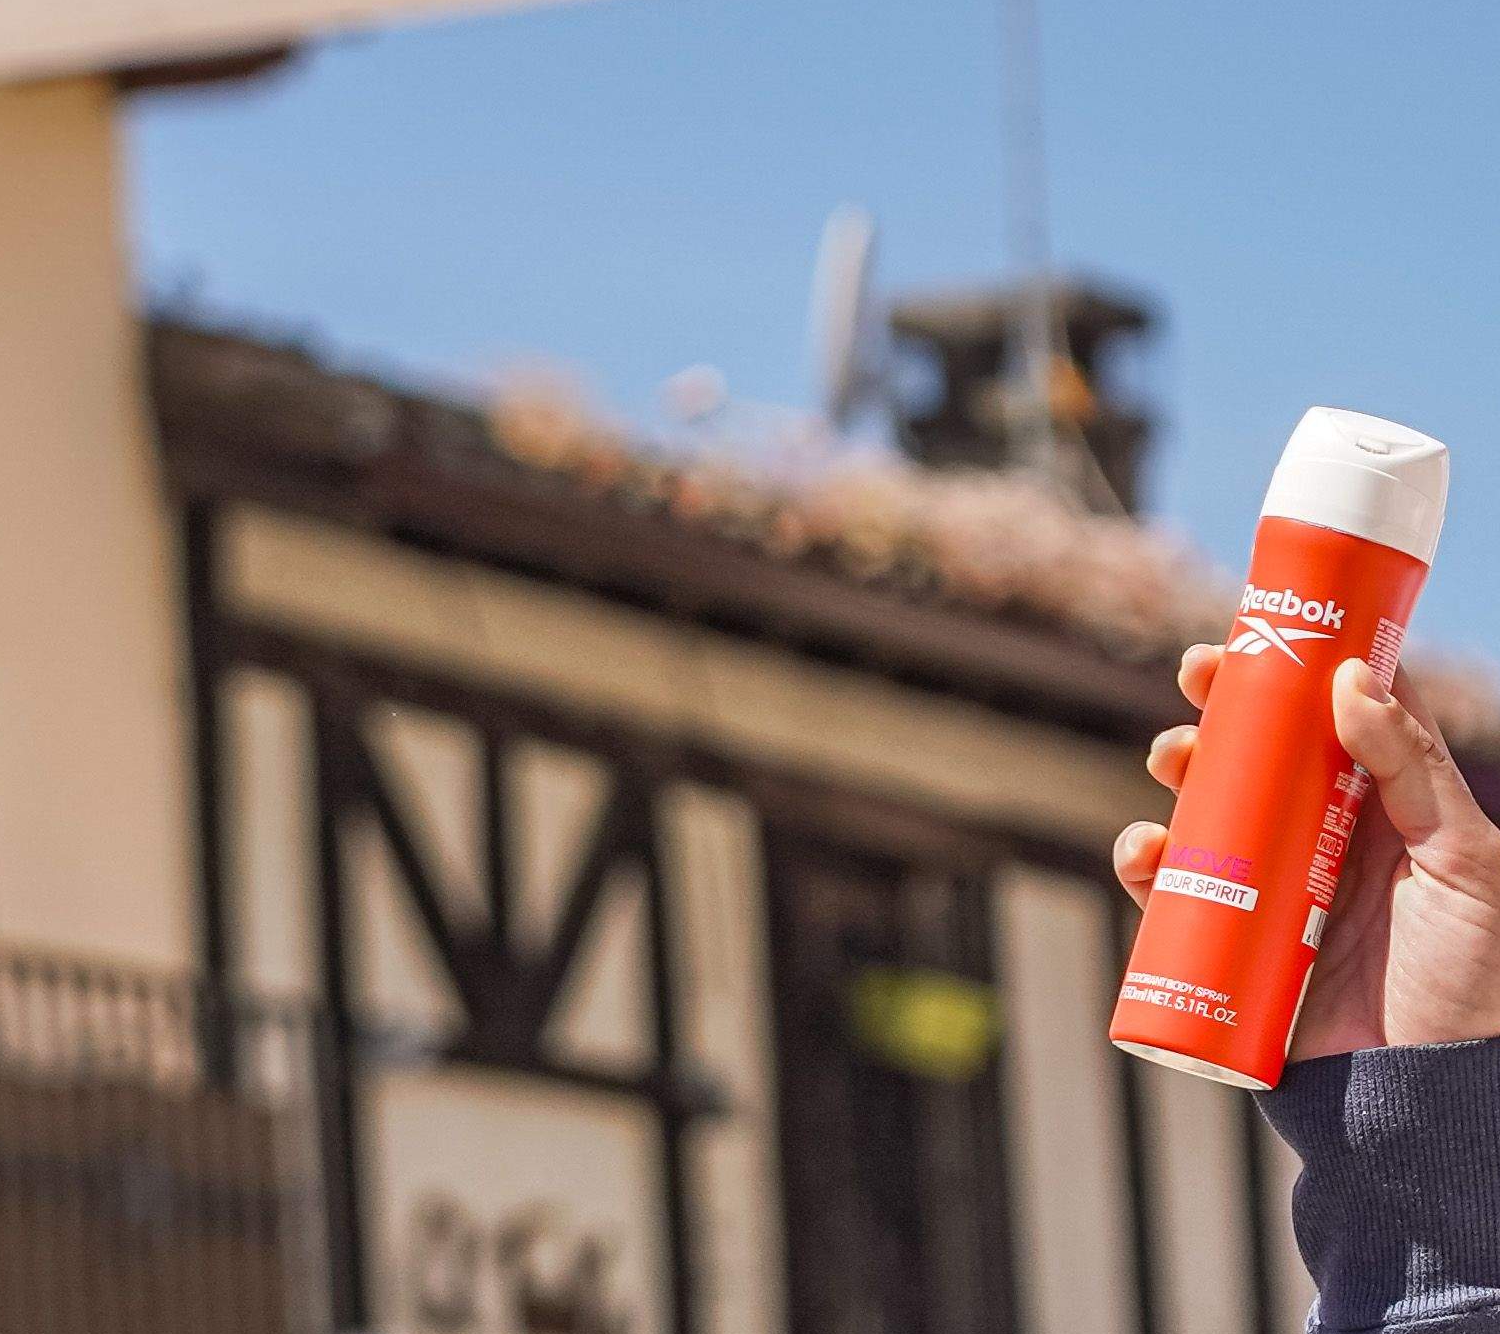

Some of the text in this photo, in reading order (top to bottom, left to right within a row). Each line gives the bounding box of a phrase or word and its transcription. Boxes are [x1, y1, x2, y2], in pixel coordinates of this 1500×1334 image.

[1240, 583, 1345, 630] Reebok
[1168, 844, 1252, 882] MOVE
[1161, 872, 1248, 906] YOUR SPIRIT
[1195, 986, 1231, 1005] SPRAY
